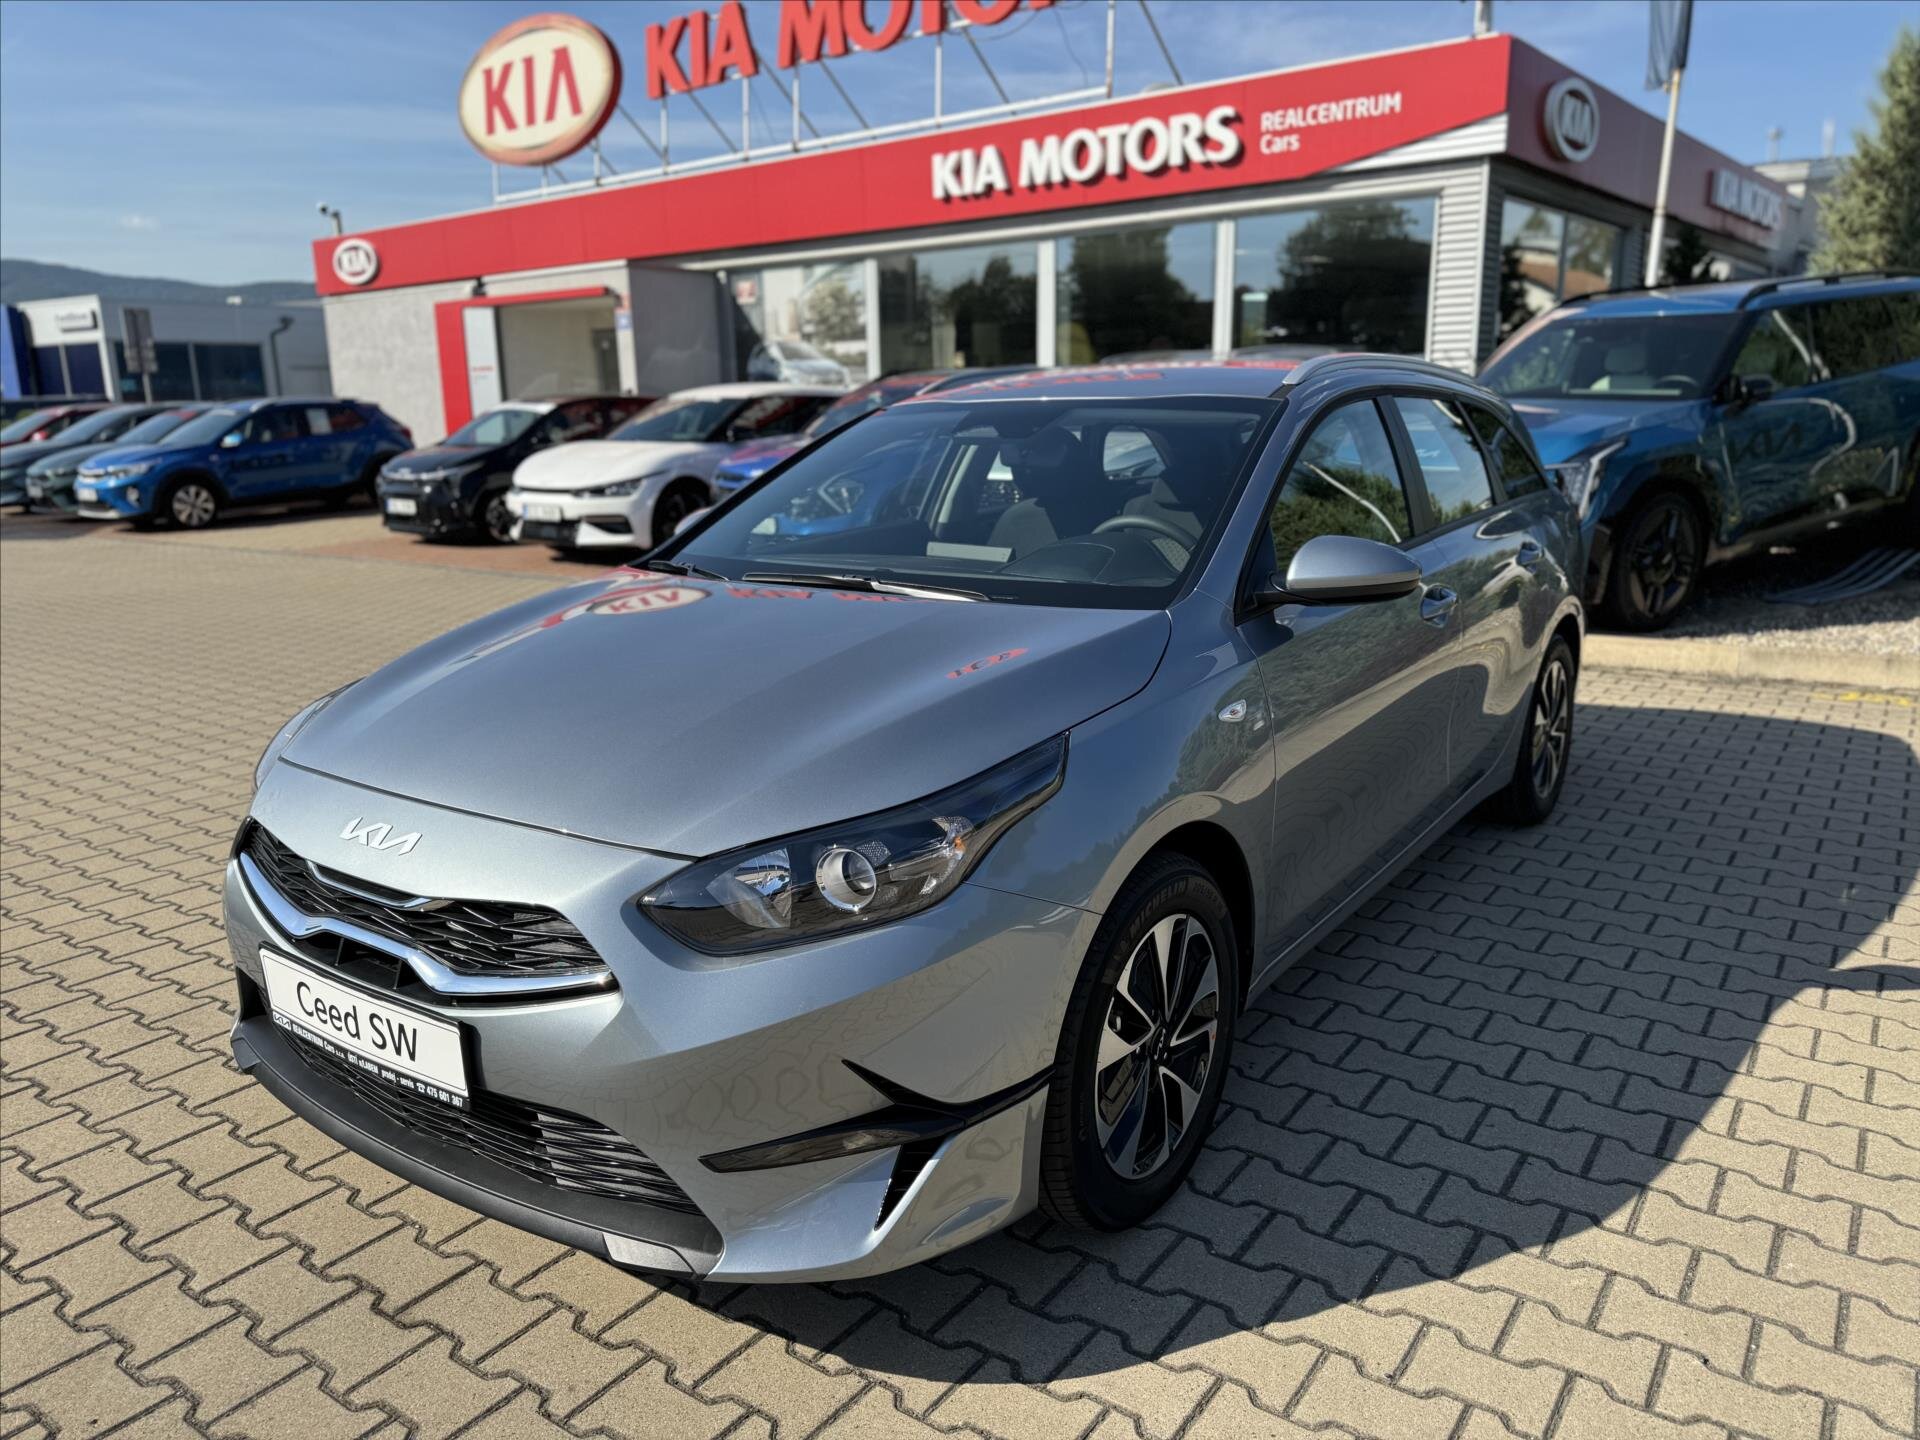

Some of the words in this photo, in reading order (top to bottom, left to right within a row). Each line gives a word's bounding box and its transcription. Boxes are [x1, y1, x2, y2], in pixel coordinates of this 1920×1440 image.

[645, 0, 758, 100] KIA
[483, 46, 583, 136] KIA
[1260, 92, 1402, 133] REALCENTRUM
[932, 145, 1008, 201] KIA
[1018, 105, 1241, 188] MOTORS
[1260, 132, 1300, 155] Cars
[338, 816, 423, 856] KIA
[1129, 878, 1189, 940] MICHELIN
[296, 981, 361, 1041] Ceed
[369, 1013, 418, 1062] SW
[426, 1086, 438, 1098] 475
[439, 1091, 450, 1103] 601
[451, 1095, 463, 1108] 367
